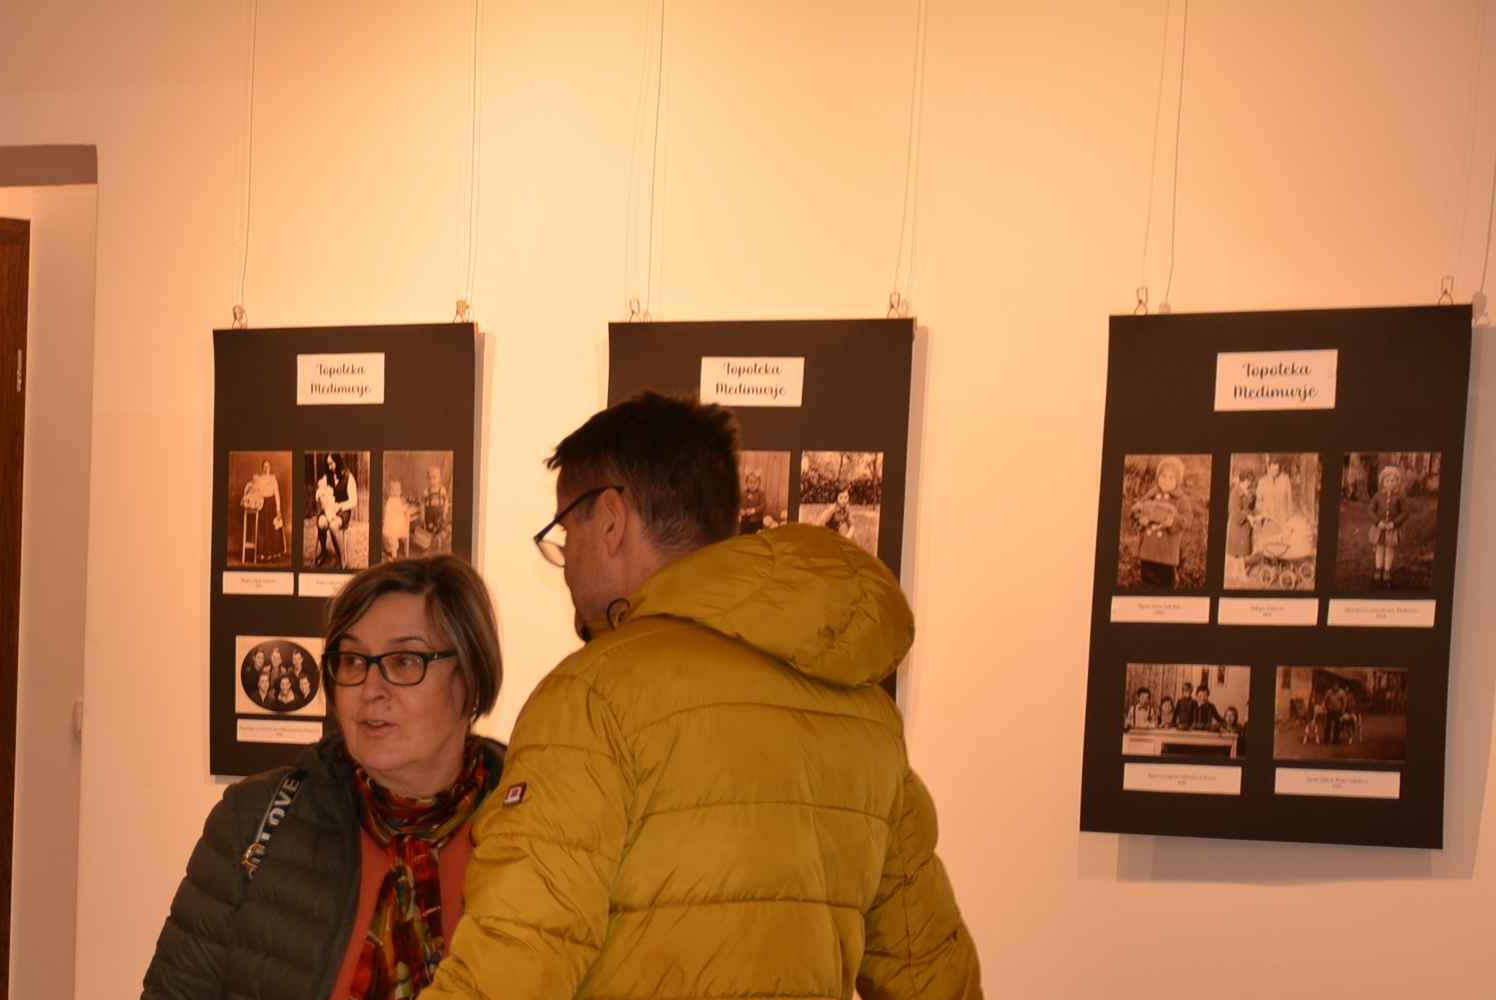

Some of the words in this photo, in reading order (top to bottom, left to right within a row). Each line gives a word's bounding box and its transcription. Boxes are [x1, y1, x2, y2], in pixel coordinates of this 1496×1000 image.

[315, 363, 367, 379] Topoteka
[722, 362, 783, 378] Topoteka
[1240, 361, 1312, 380] Topoteka
